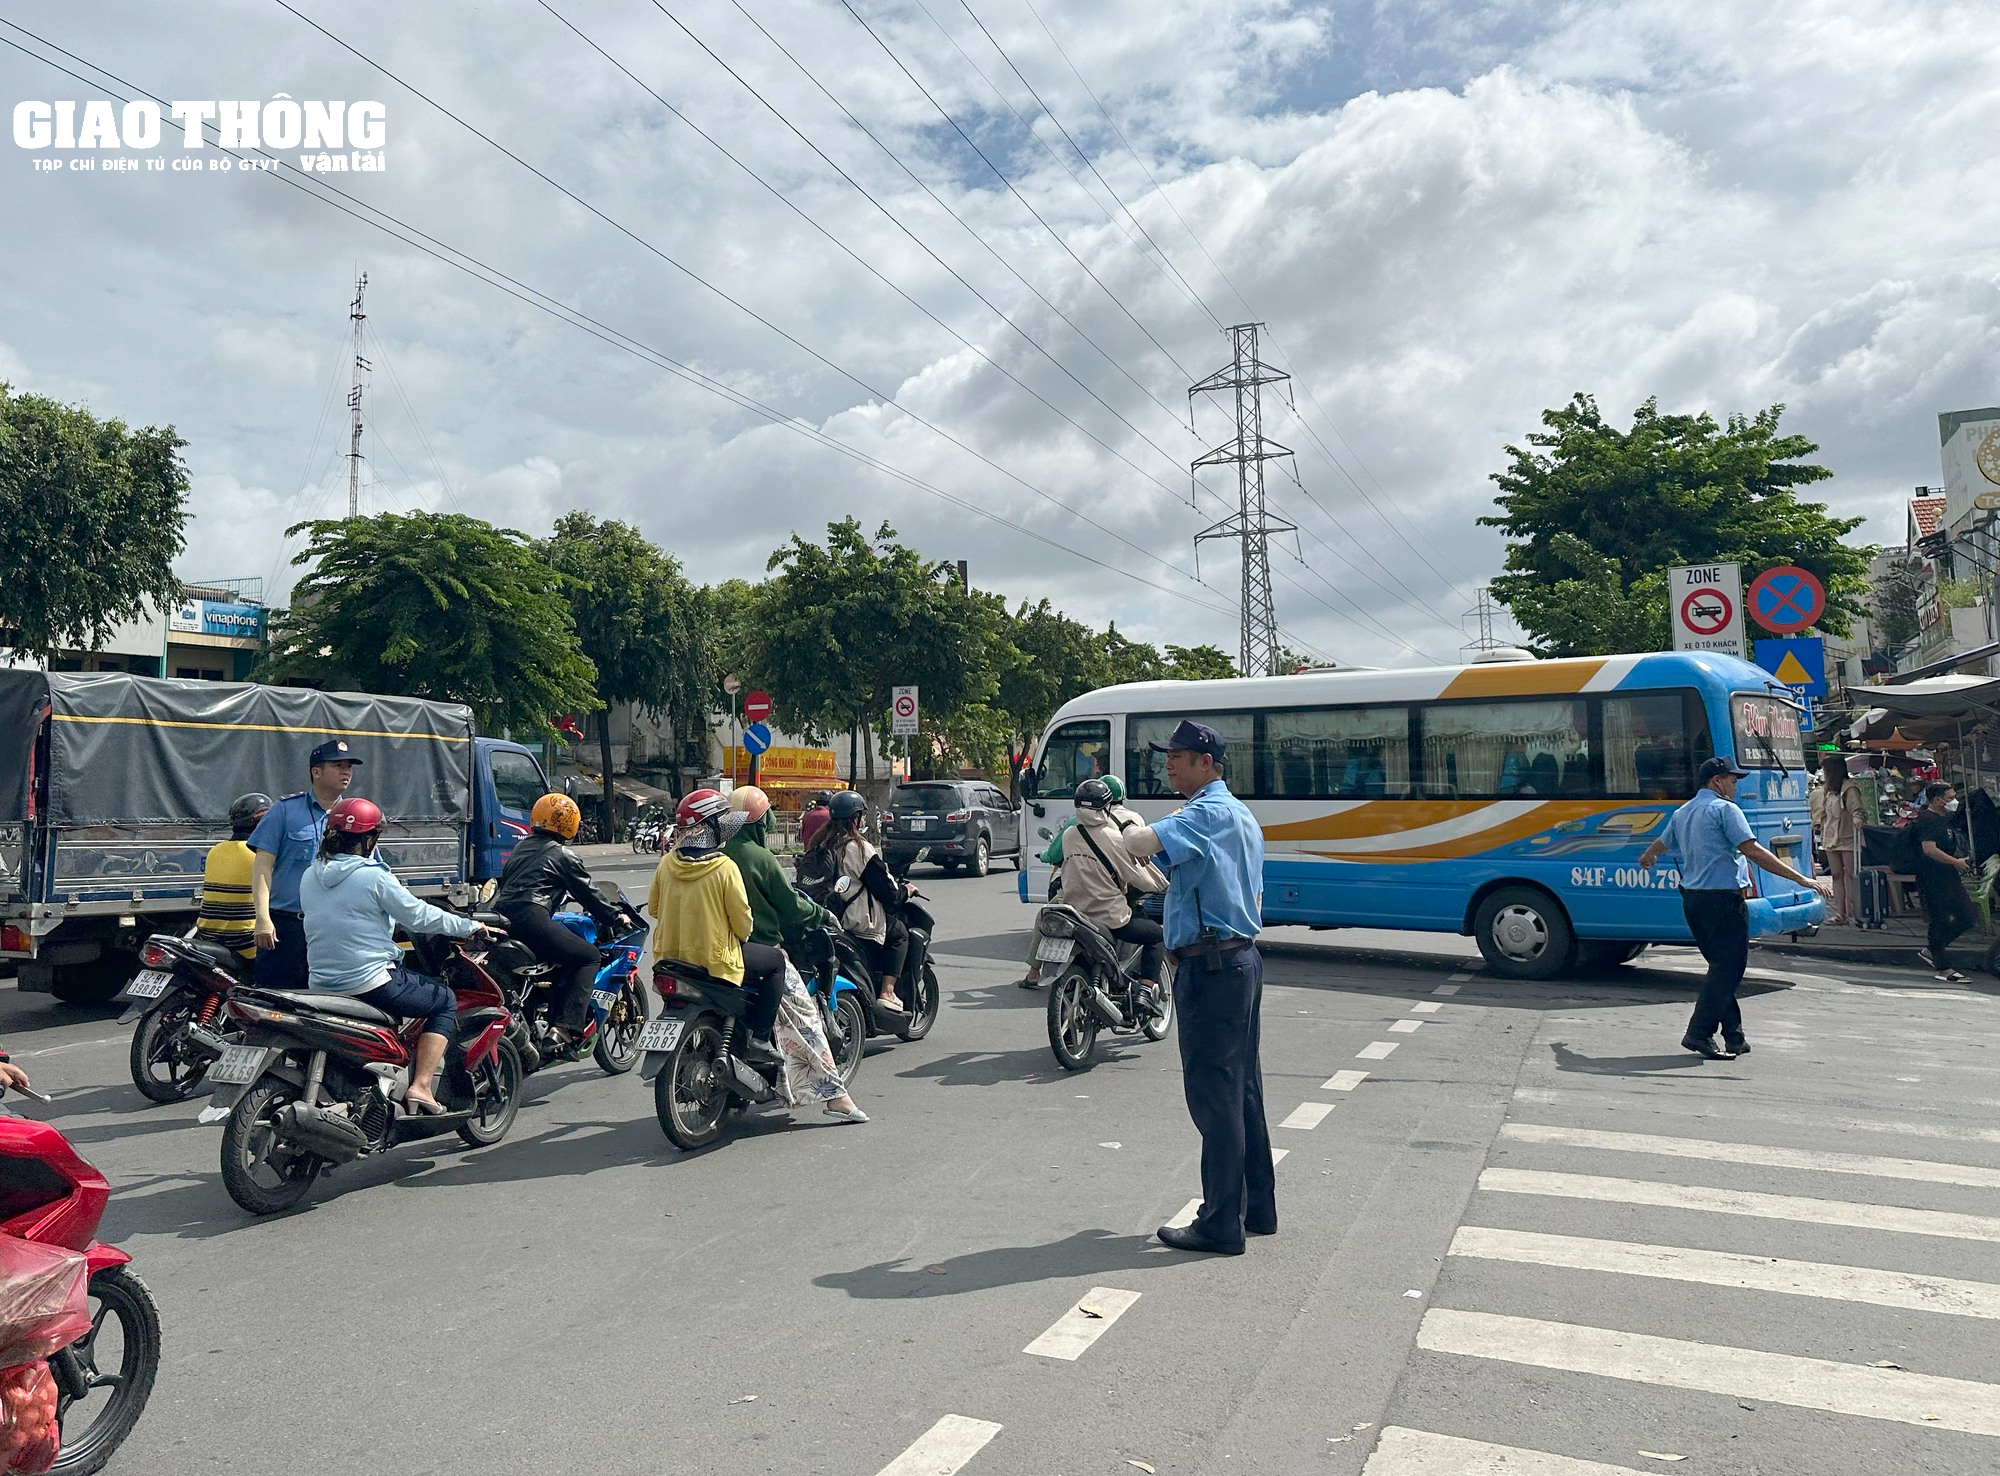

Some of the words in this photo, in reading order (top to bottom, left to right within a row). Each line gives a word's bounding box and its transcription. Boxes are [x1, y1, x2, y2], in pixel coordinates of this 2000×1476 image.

[1686, 568, 1721, 585] ZONE
[205, 610, 258, 627] vinaphone
[1702, 641, 1711, 649] TÔ
[1712, 639, 1737, 649] KHÁCH
[898, 687, 912, 695] ZONE
[1570, 866, 1681, 889] 84F-000.79
[647, 1022, 678, 1036] 59-P2
